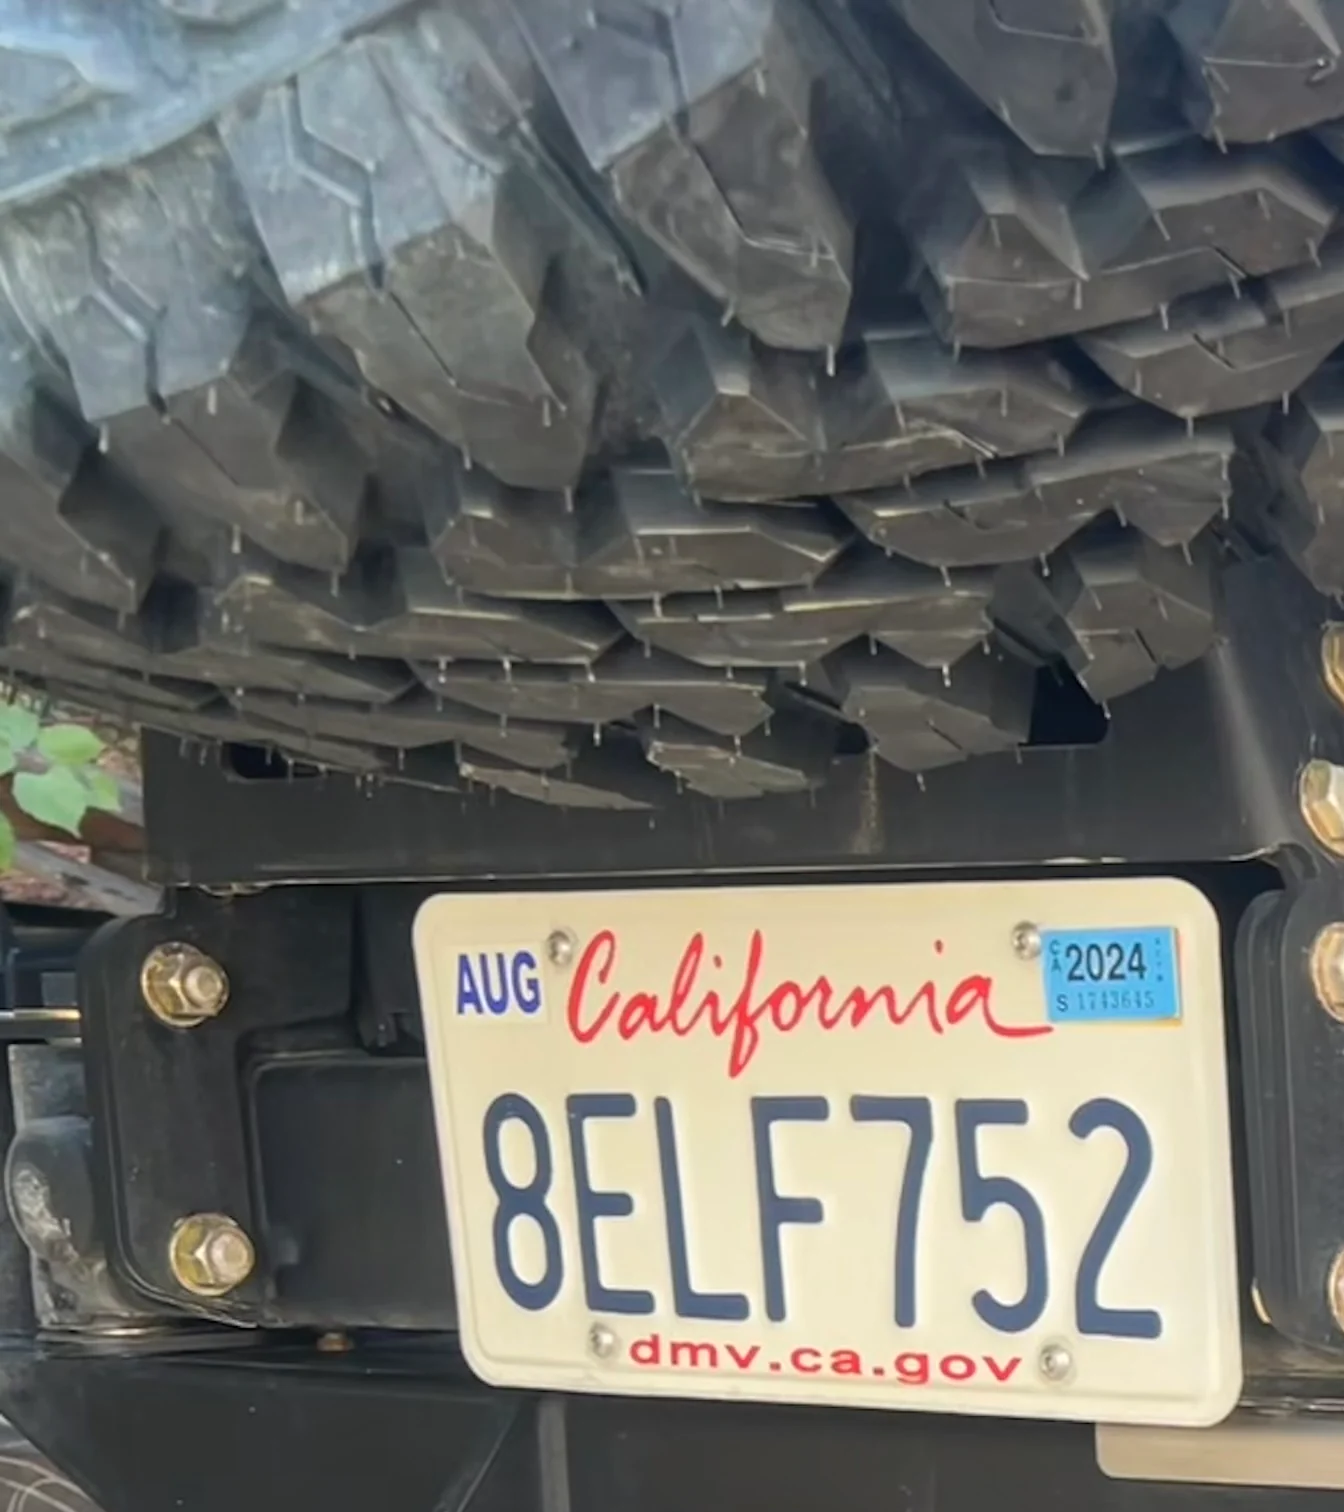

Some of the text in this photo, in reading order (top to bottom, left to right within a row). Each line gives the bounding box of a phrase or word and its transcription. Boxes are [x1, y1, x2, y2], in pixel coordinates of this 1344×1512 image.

[455, 949, 543, 1016] AUG
[1064, 941, 1148, 982] 2024
[565, 928, 1054, 1078] California
[482, 1092, 1163, 1340] 8ELF752
[629, 1333, 1022, 1386] dmv.ca.gov
